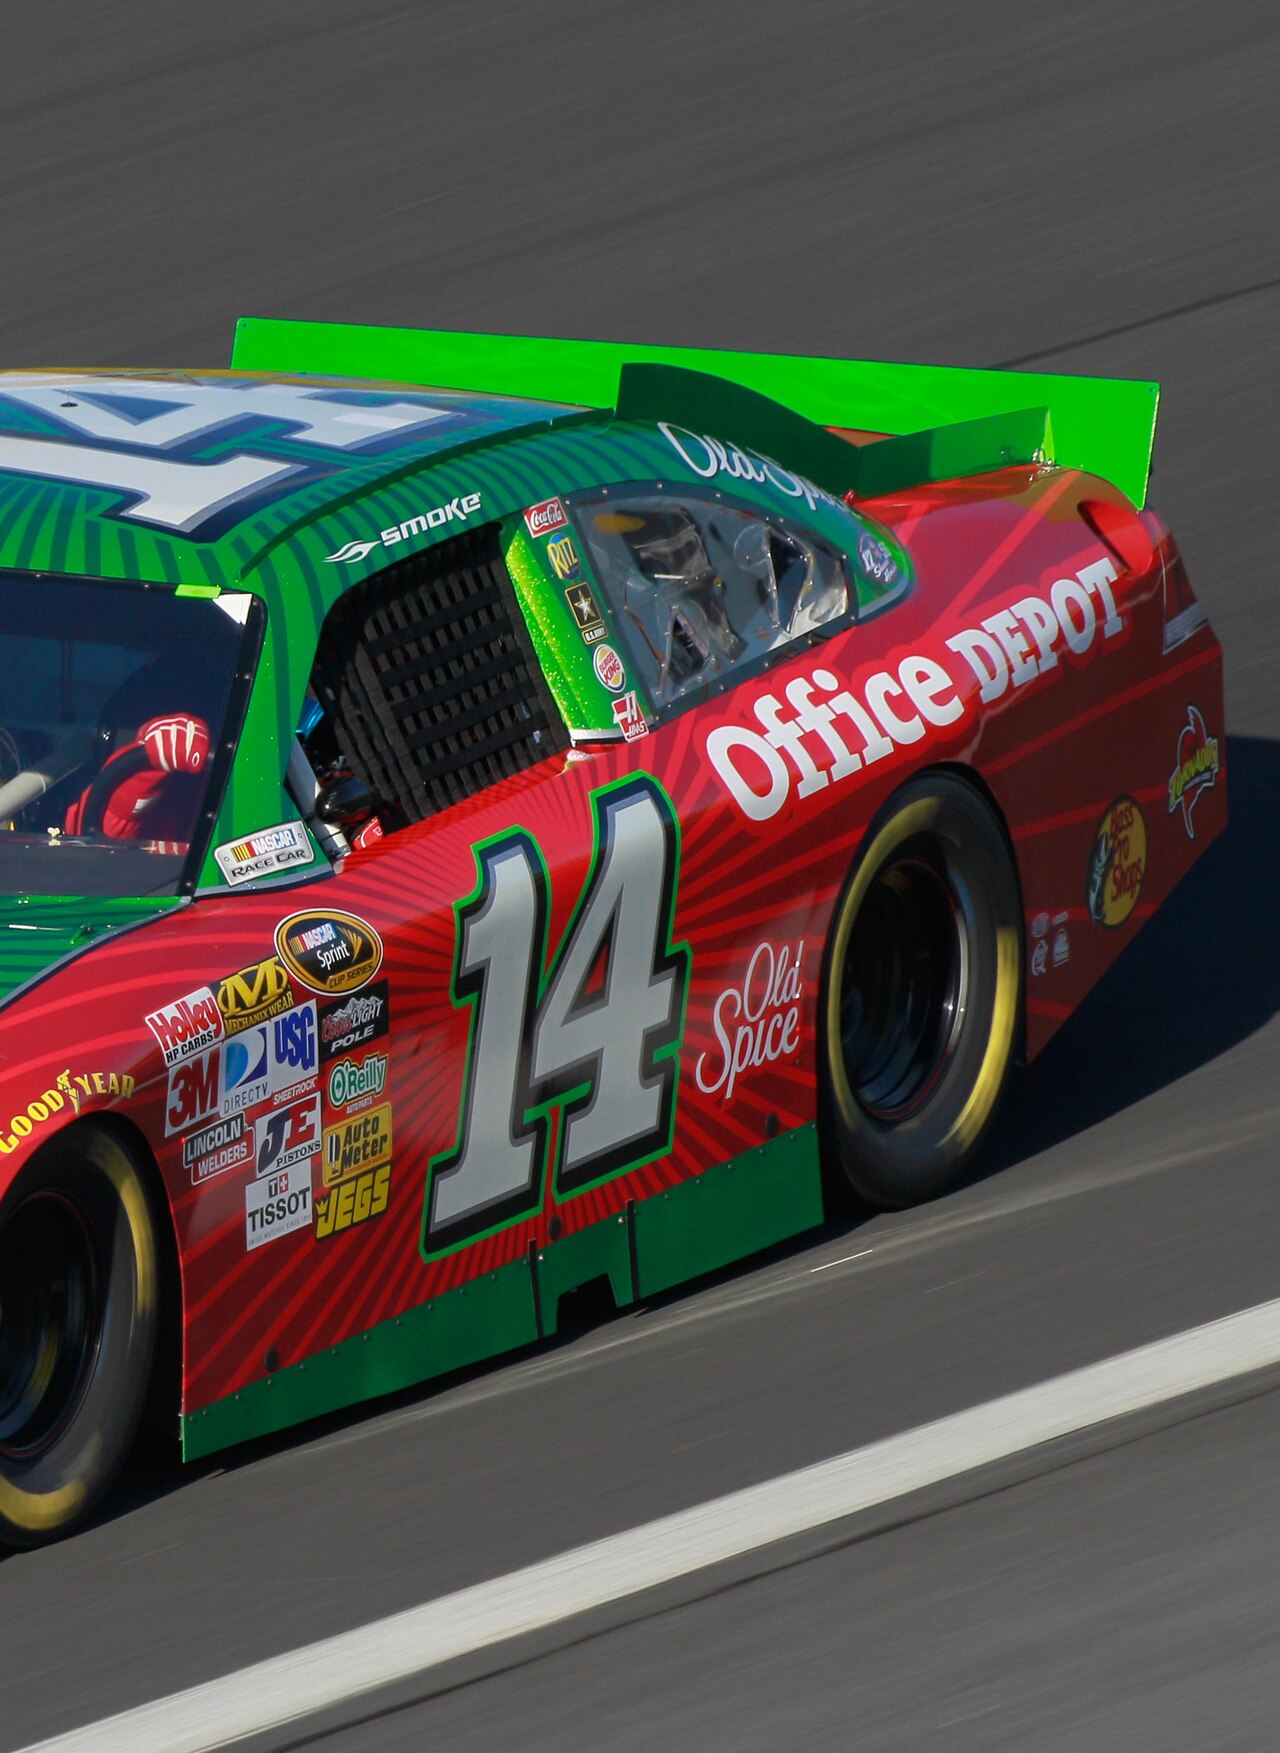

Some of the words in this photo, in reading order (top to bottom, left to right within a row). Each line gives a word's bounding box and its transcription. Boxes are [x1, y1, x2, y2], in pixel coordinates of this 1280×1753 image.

[657, 421, 765, 483] Old
[548, 537, 579, 580] RITZ
[603, 660, 621, 686] KING
[705, 669, 965, 821] Office
[945, 557, 1125, 704] DEPOT
[251, 829, 297, 855] NASCAR
[231, 858, 275, 878] RACE
[276, 849, 308, 863] CAR
[302, 923, 337, 950] NASCAR
[317, 940, 351, 971] Sprint
[328, 974, 347, 990] CUP
[346, 962, 375, 981] SERIES
[745, 941, 803, 1023] Old
[148, 996, 223, 1051] Holley
[224, 1008, 269, 1034] MECHANIX
[269, 991, 295, 1017] WEAR
[351, 1000, 384, 1029] LIGHT
[428, 788, 680, 1230] 14
[165, 1047, 180, 1064] HP
[181, 1030, 215, 1056] CARBS
[274, 1005, 316, 1072] USG
[331, 1024, 375, 1053] POLE
[696, 988, 800, 1099] Spice
[168, 1049, 220, 1128] 3M
[223, 1081, 269, 1115] DIRECTV
[273, 1076, 317, 1106] SHEETROCK
[329, 1058, 387, 1107] O'Reilly
[185, 1118, 241, 1161] LINCOLN
[257, 1098, 319, 1173] JE
[342, 1132, 389, 1170] Meter
[343, 1115, 380, 1147] Auto
[197, 1141, 248, 1177] WELDERS
[275, 1141, 321, 1168] PISTONS
[247, 1187, 311, 1232] TISSOT
[315, 1165, 392, 1240] JEGS
